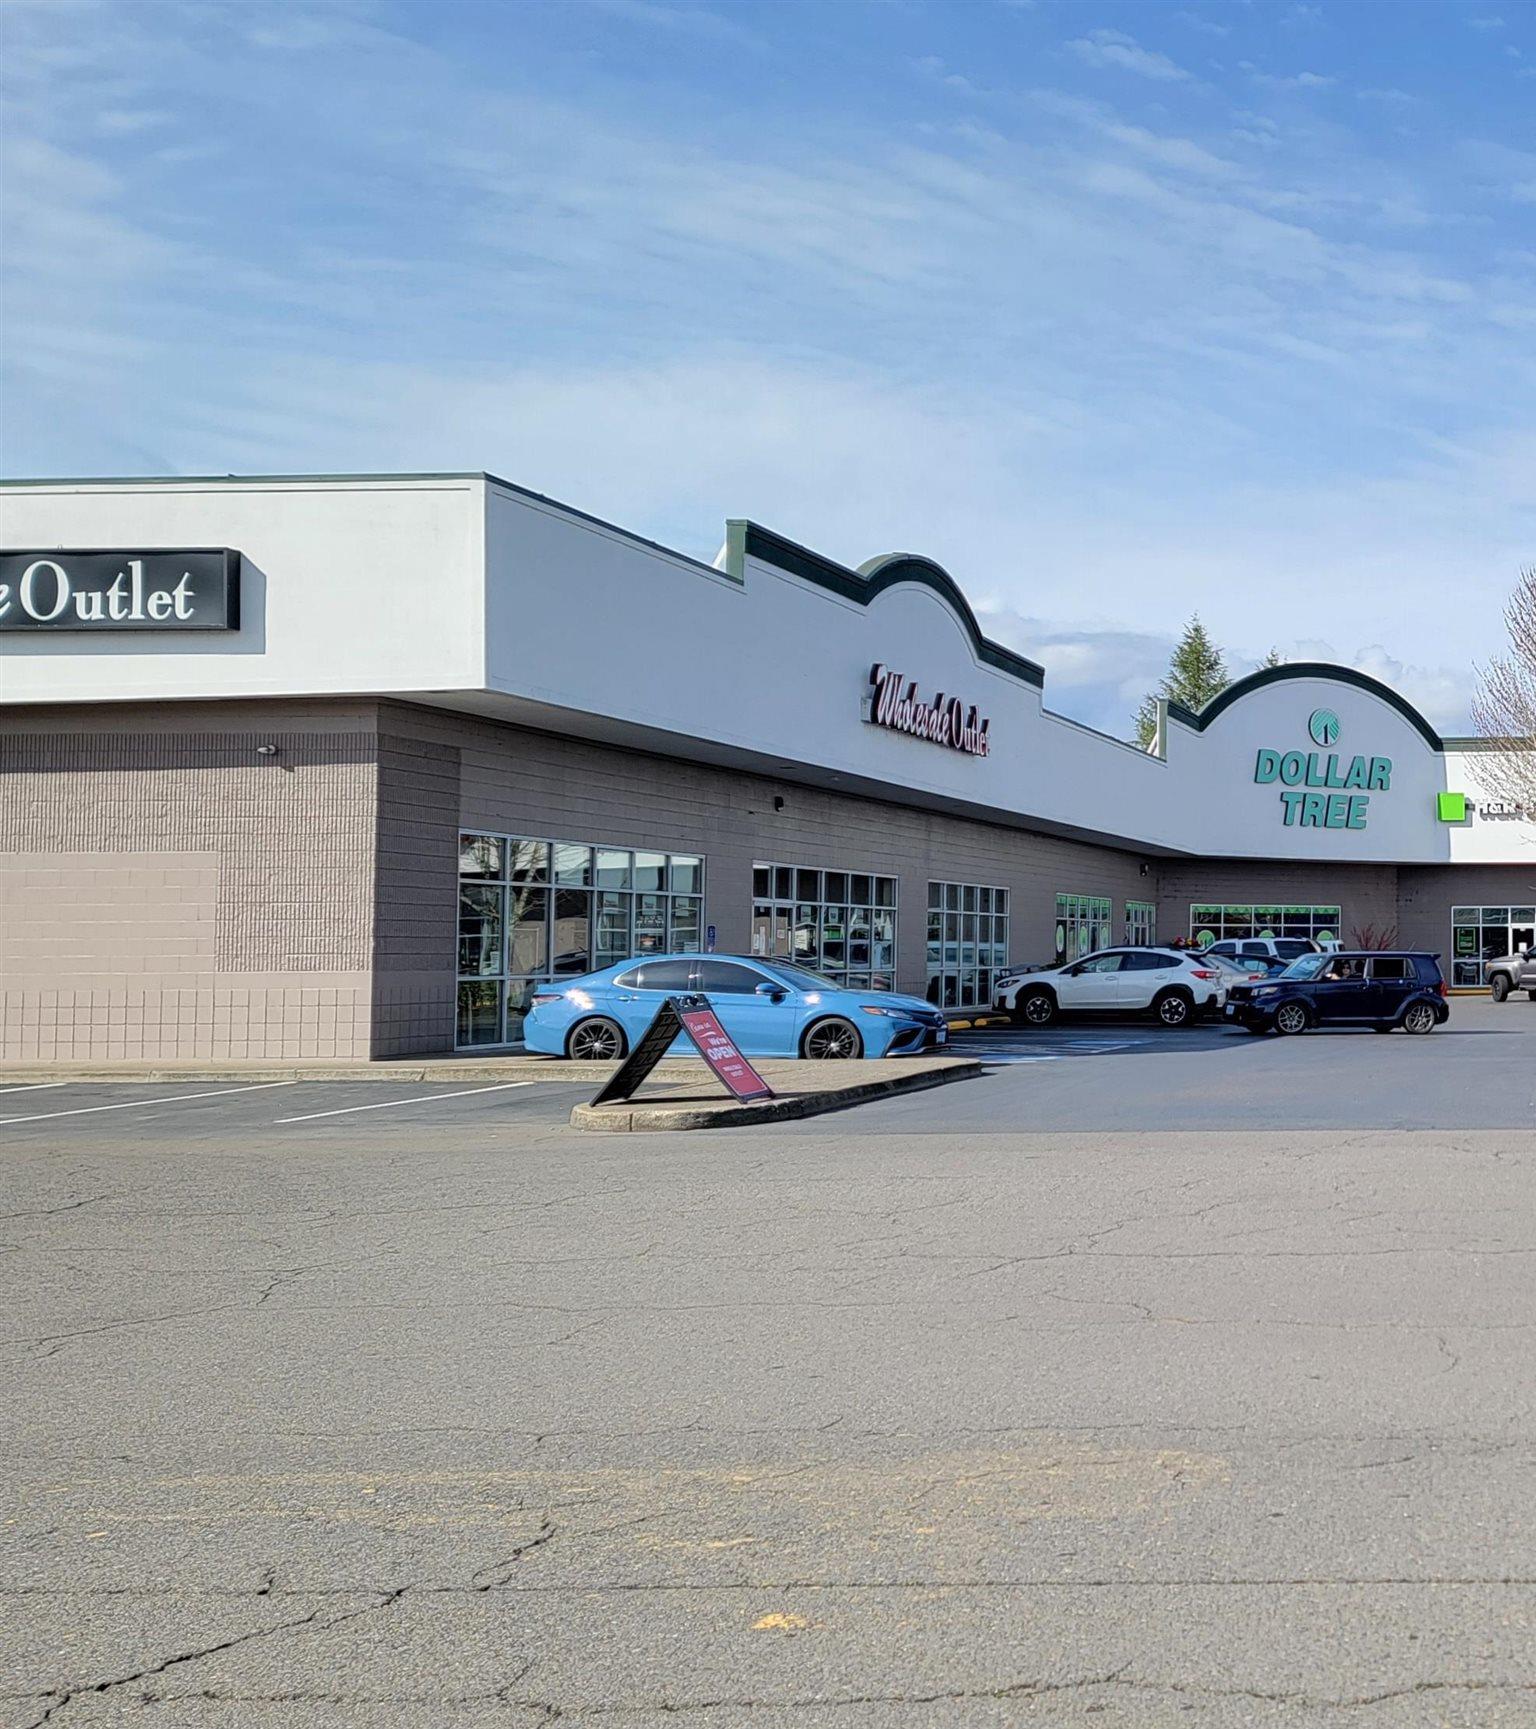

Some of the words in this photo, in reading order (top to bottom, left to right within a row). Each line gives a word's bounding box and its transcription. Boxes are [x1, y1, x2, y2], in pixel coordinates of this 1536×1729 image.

[20, 560, 195, 621] Outlet
[870, 663, 950, 744] Wholesale
[948, 697, 990, 757] Outlet
[1254, 749, 1393, 790] DOLLAR
[1280, 792, 1370, 829] TREE
[706, 1045, 737, 1061] OPEN
